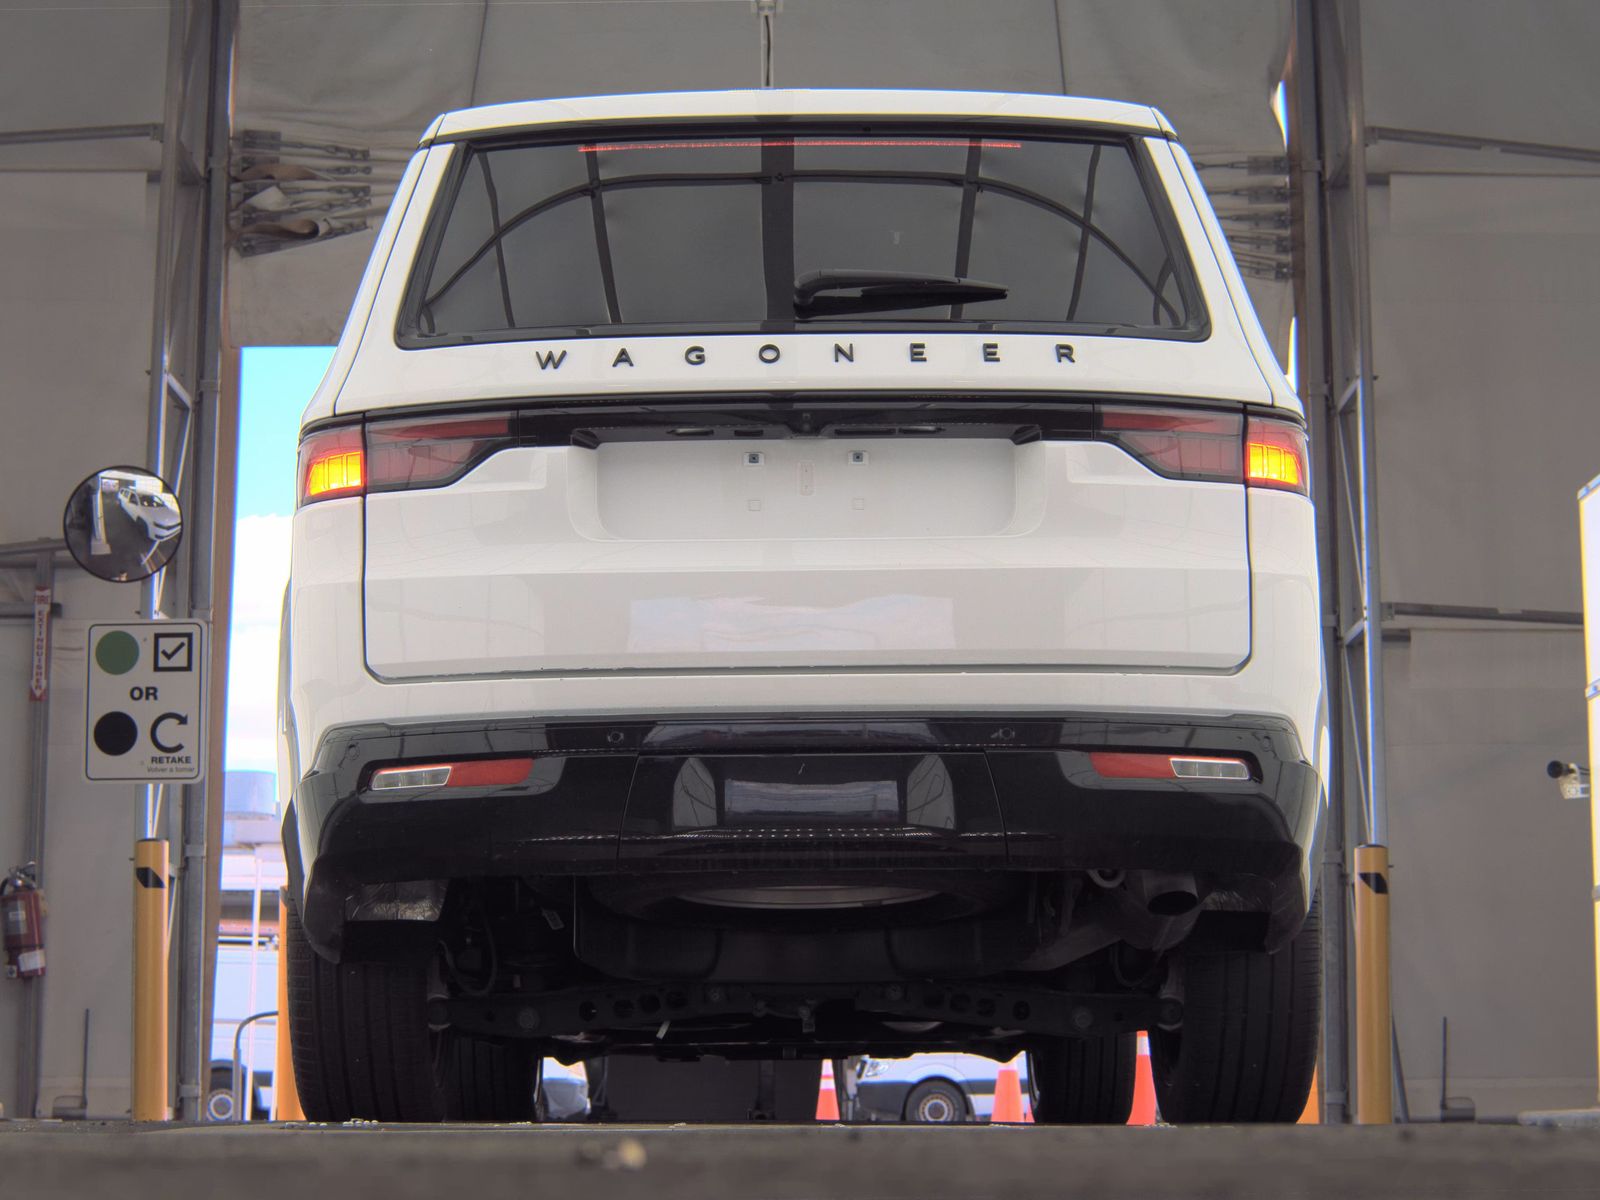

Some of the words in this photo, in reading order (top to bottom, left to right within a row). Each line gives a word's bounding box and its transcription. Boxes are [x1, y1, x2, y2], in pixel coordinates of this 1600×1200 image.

[536, 342, 1077, 371] WAGONEER
[129, 686, 159, 701] OR
[151, 756, 192, 764] RETAKE
